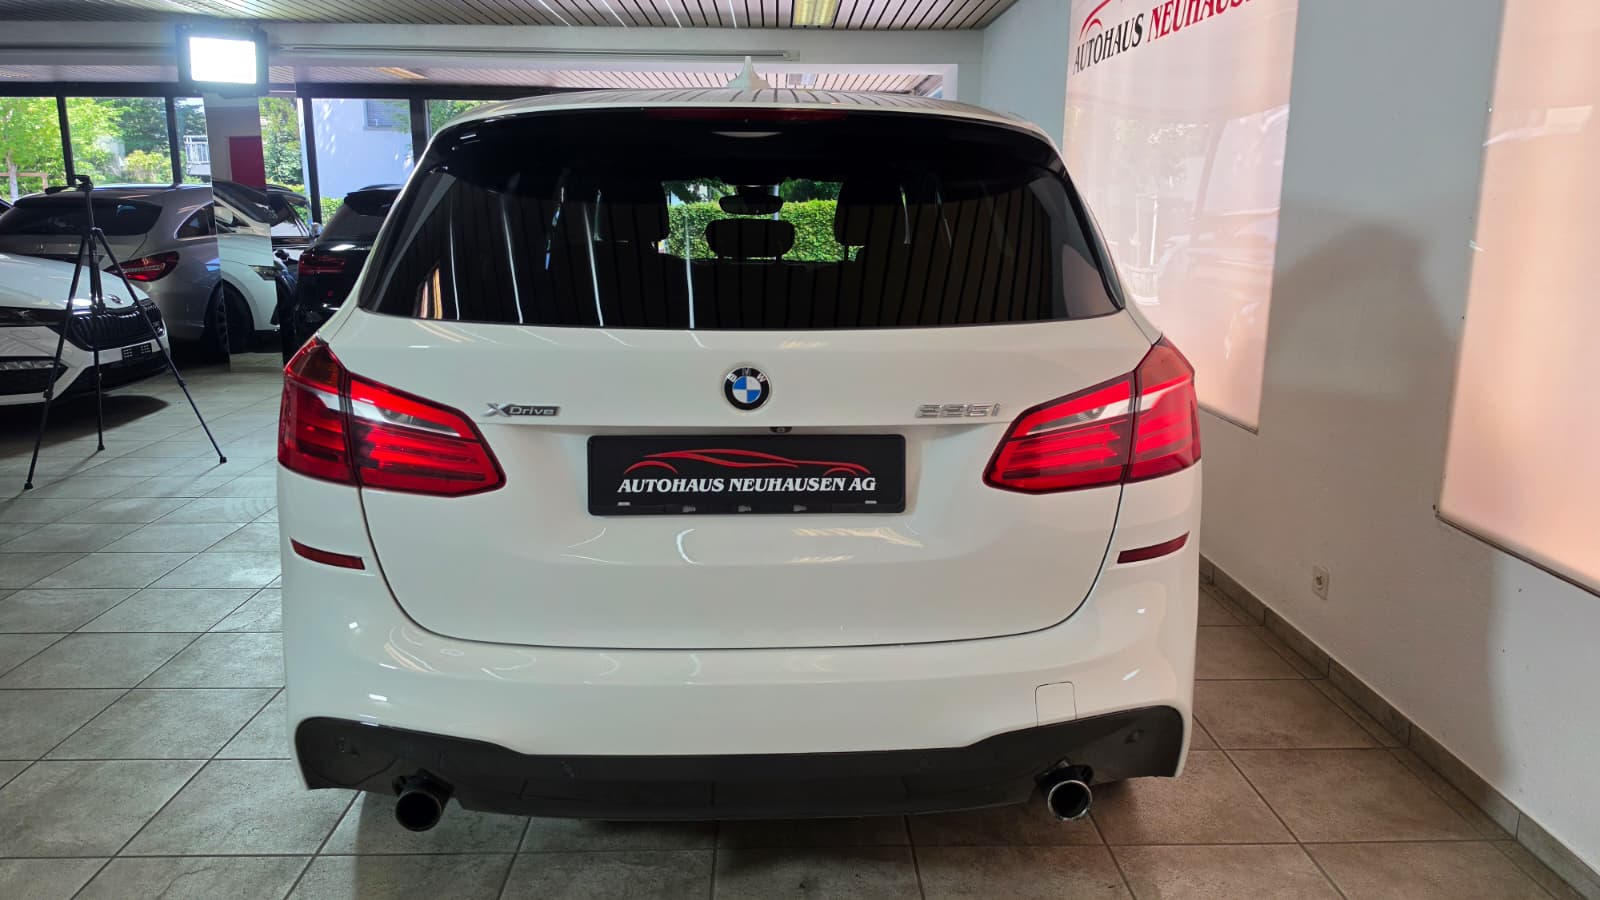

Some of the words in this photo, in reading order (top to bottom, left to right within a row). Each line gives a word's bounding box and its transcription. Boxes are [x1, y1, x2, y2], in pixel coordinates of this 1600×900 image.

[1072, 13, 1144, 75] AUTOHAUS
[617, 478, 725, 493] AUTOHAUS
[728, 477, 846, 492] NEUHAUSEN
[848, 477, 877, 491] AG
